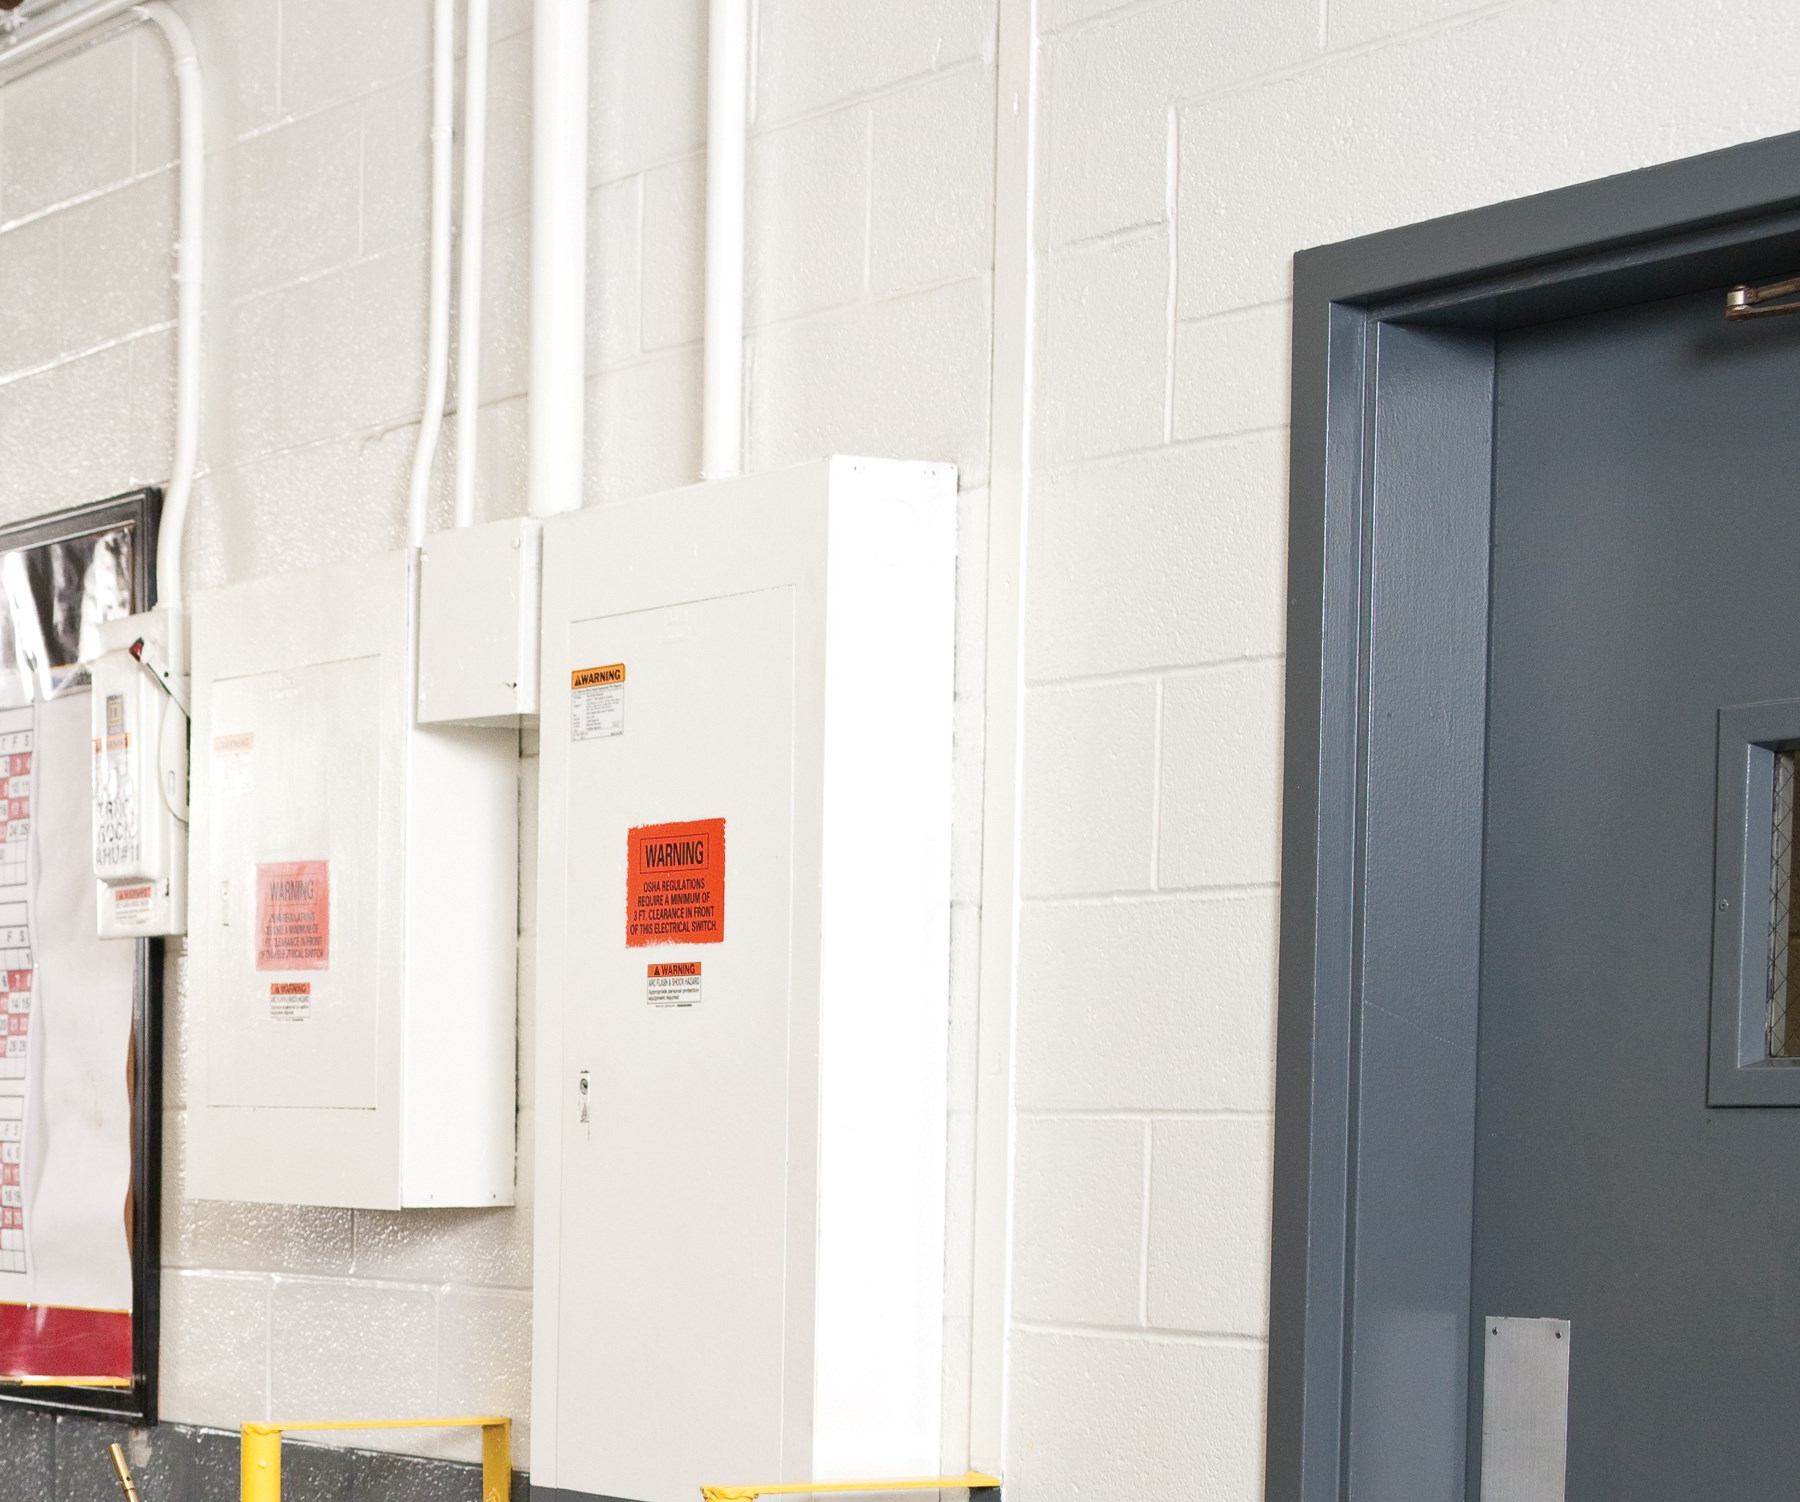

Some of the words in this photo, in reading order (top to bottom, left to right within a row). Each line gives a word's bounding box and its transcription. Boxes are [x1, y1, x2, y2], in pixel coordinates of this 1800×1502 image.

[581, 669, 621, 685] WARNING
[645, 840, 704, 868] WARNING
[270, 880, 314, 902] WARNING
[643, 881, 660, 893] OSHA
[661, 878, 705, 892] REGULATIONS
[637, 895, 663, 907] REQUIRE
[664, 894, 669, 905] A
[670, 893, 701, 905] MINIMUM
[701, 892, 710, 903] OF
[648, 907, 684, 920] CLEARANCE
[685, 907, 692, 918] IN
[693, 906, 715, 917] FRONT
[630, 923, 639, 935] OF
[640, 922, 653, 934] THIS
[654, 921, 690, 934] ELECTRICAL
[661, 963, 695, 975] WARNING
